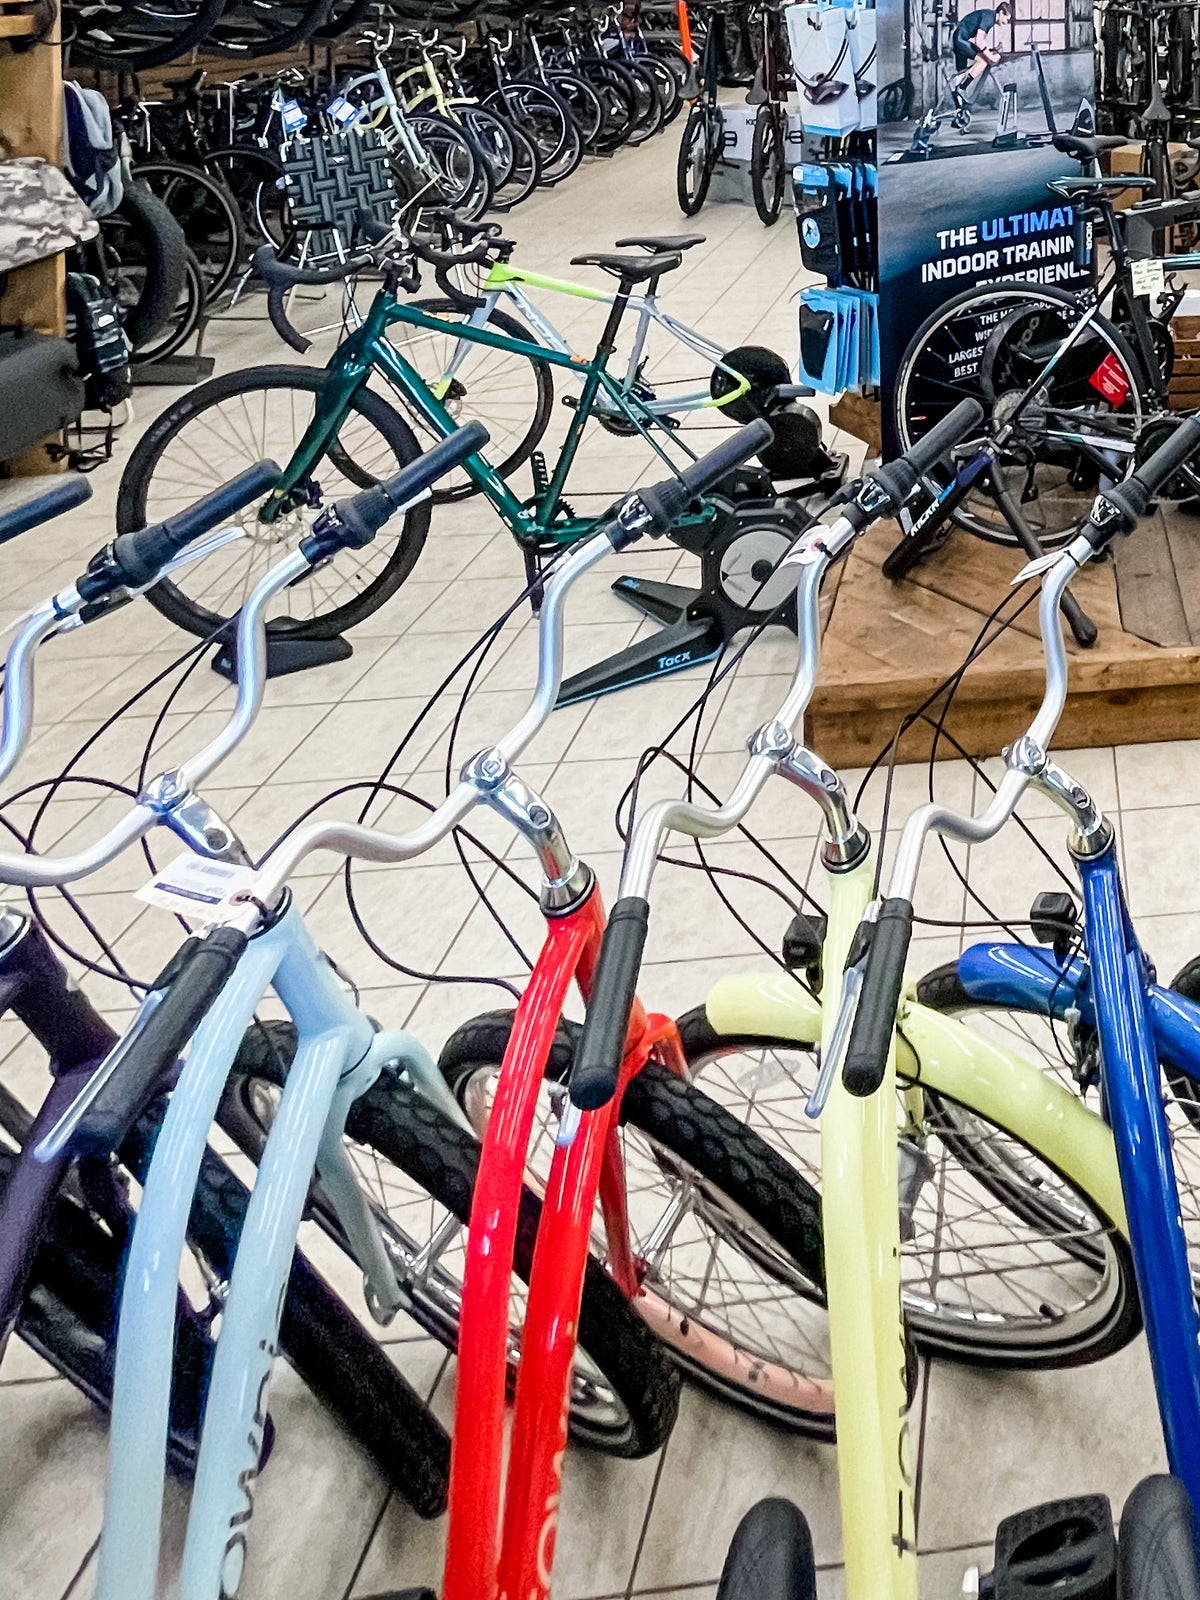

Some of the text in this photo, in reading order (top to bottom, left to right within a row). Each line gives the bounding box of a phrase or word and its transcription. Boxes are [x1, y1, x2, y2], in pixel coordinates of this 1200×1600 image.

[937, 206, 1073, 250] THE ULTIMAT
[922, 235, 1075, 283] INDOOR TRAININ
[980, 312, 998, 325] THE
[954, 361, 978, 378] BEST
[657, 650, 691, 669] Tacx
